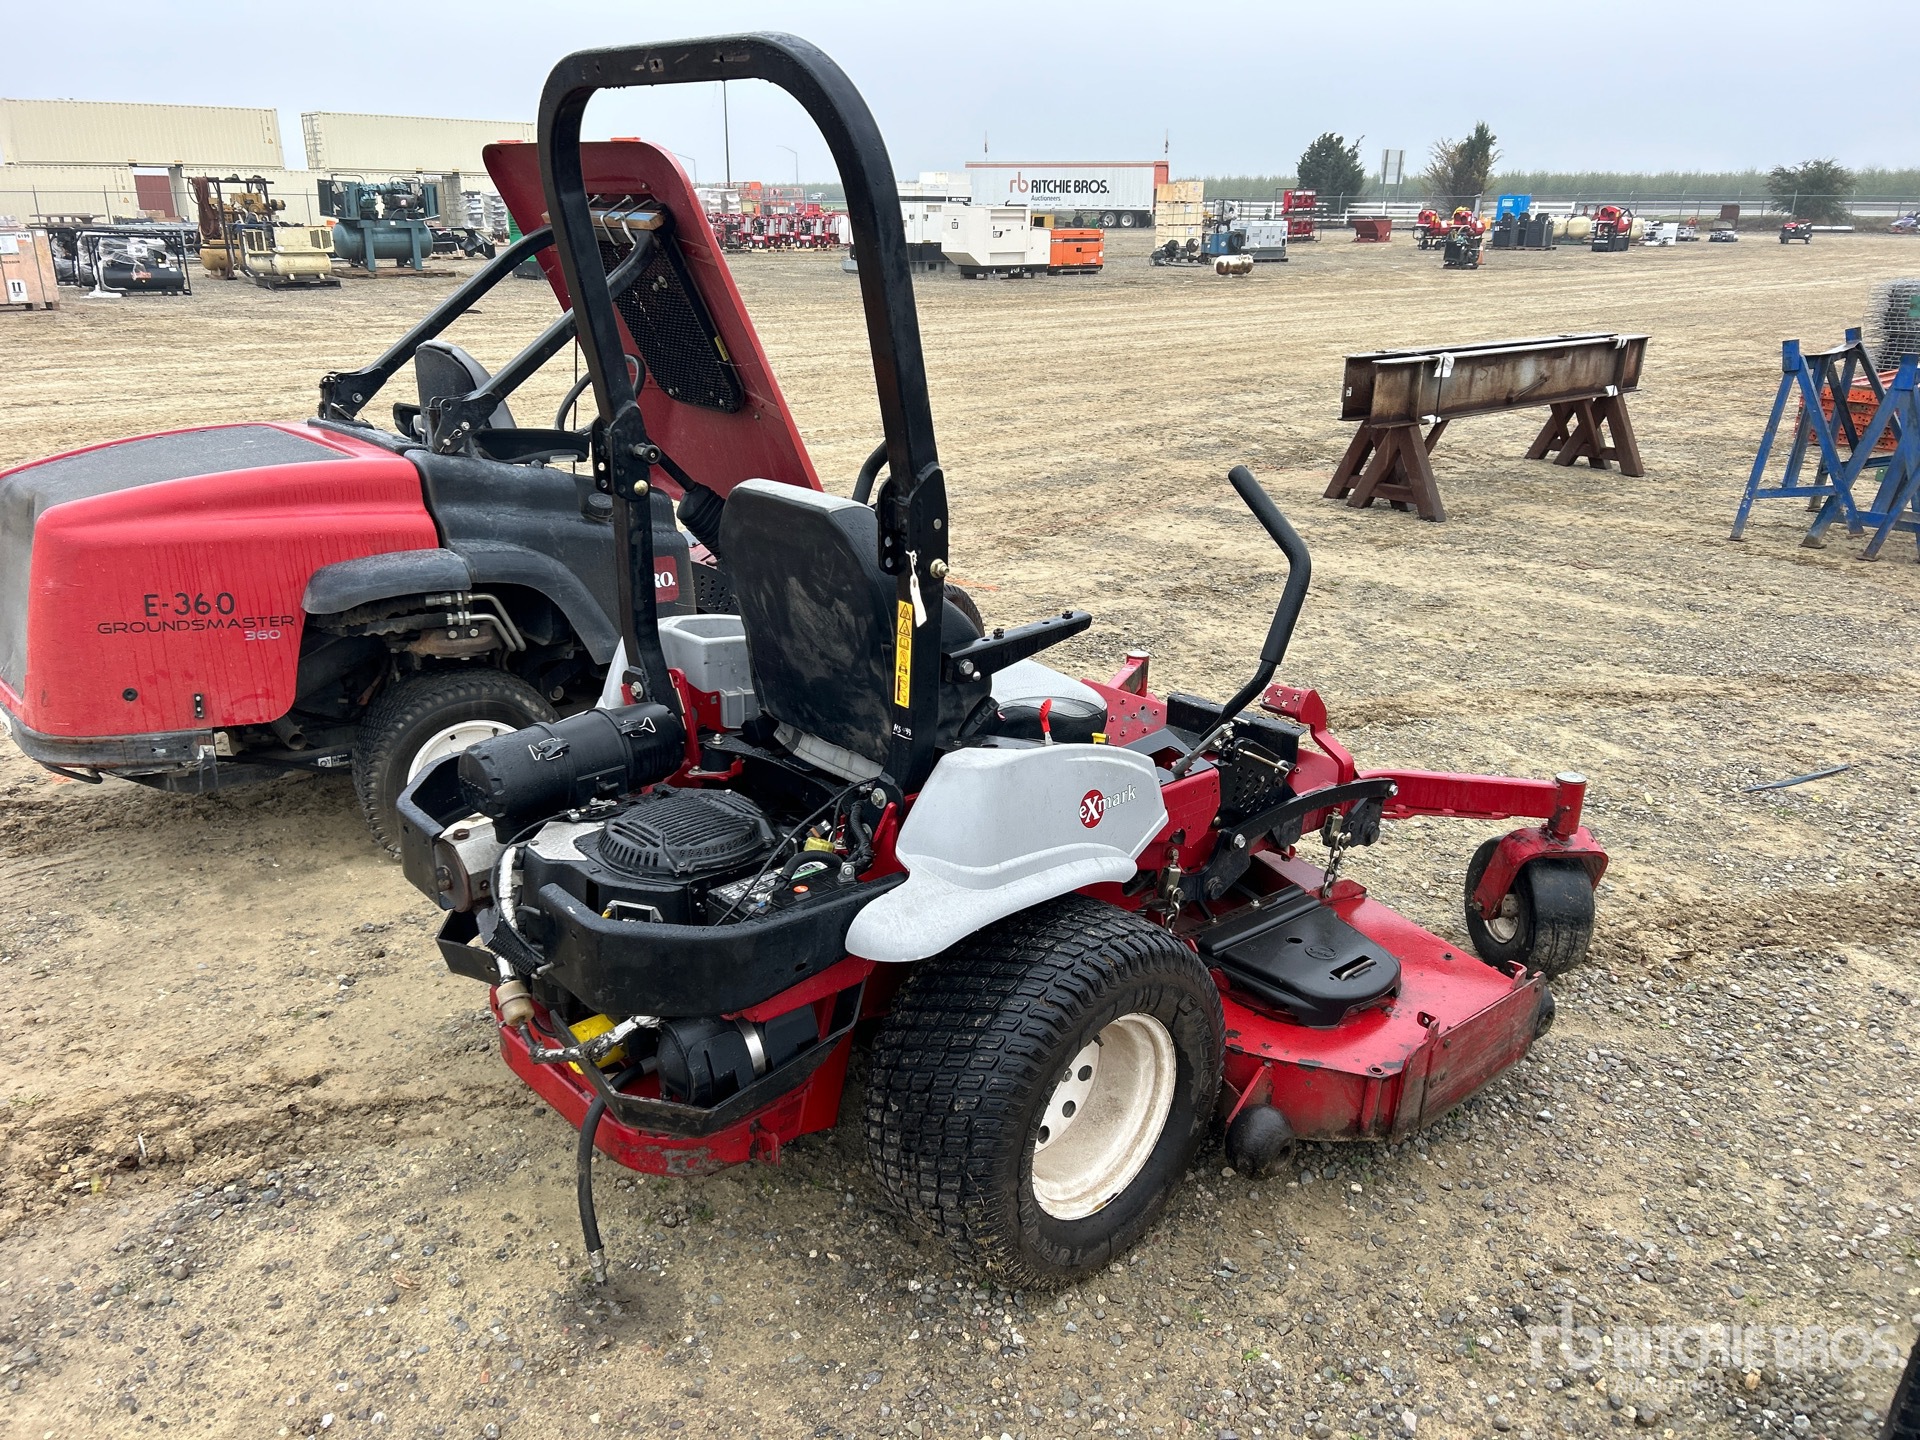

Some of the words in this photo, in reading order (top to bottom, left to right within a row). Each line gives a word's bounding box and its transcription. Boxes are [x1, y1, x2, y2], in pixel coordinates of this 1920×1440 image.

[1031, 179, 1072, 193] RITCHIE
[1073, 179, 1110, 193] BROS.
[143, 591, 235, 617] E-360
[97, 615, 295, 635] GROUNDSMASTER
[243, 629, 281, 641] 360
